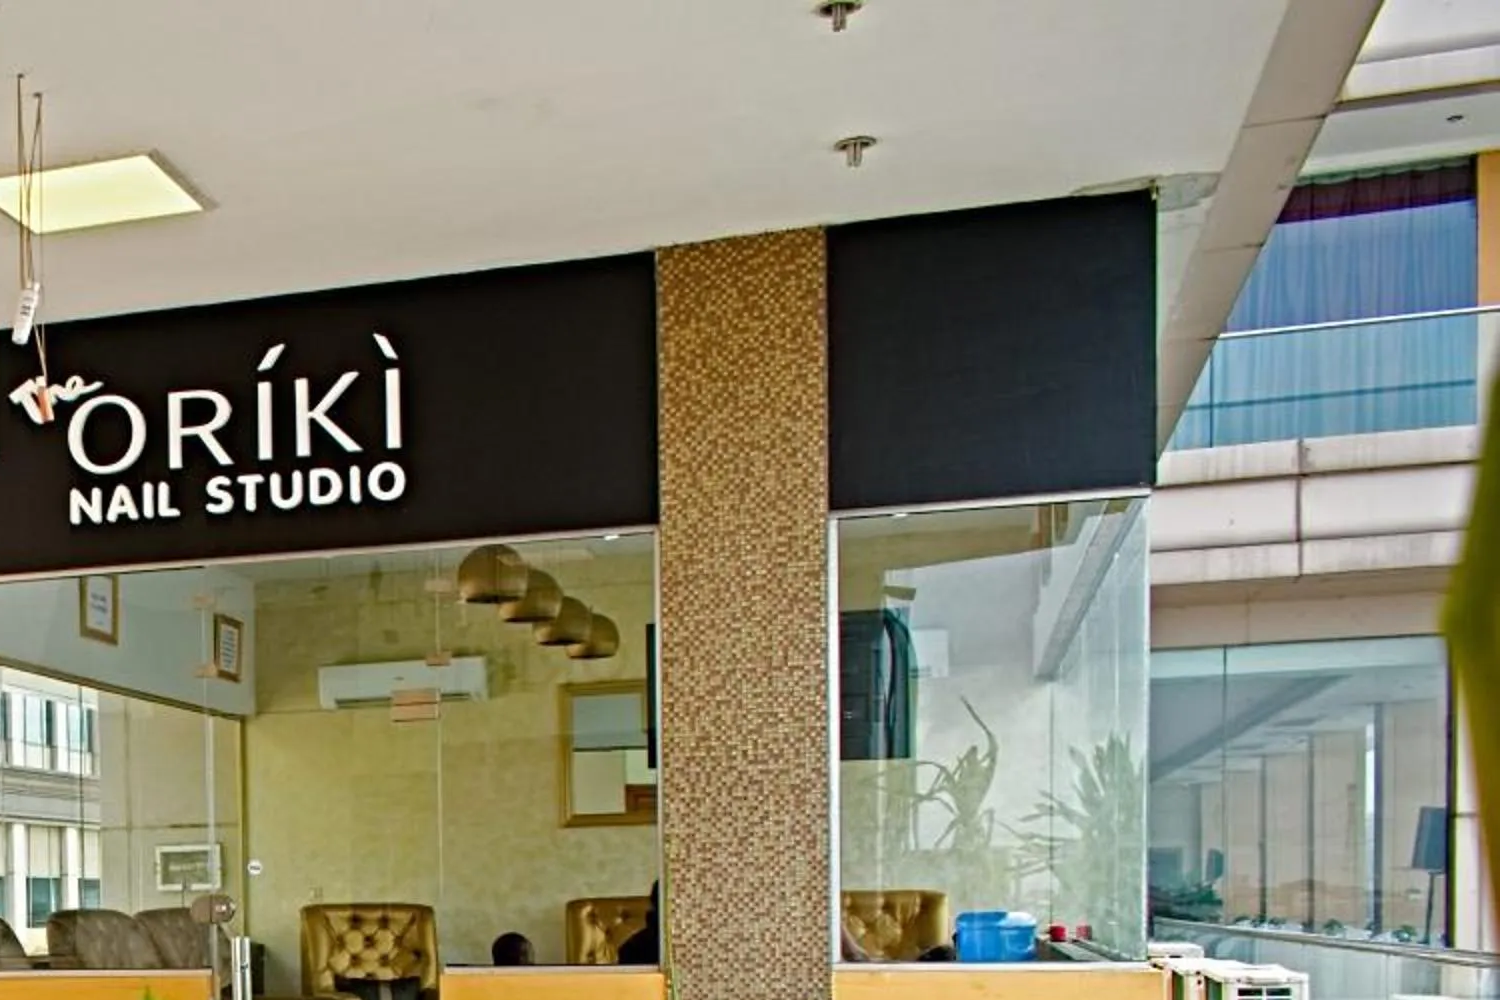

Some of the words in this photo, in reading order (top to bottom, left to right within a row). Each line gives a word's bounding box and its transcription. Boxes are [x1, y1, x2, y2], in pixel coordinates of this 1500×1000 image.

[67, 333, 402, 475] ORÍKÌ
[69, 481, 181, 525] NAIL
[205, 462, 406, 515] STUDIO
